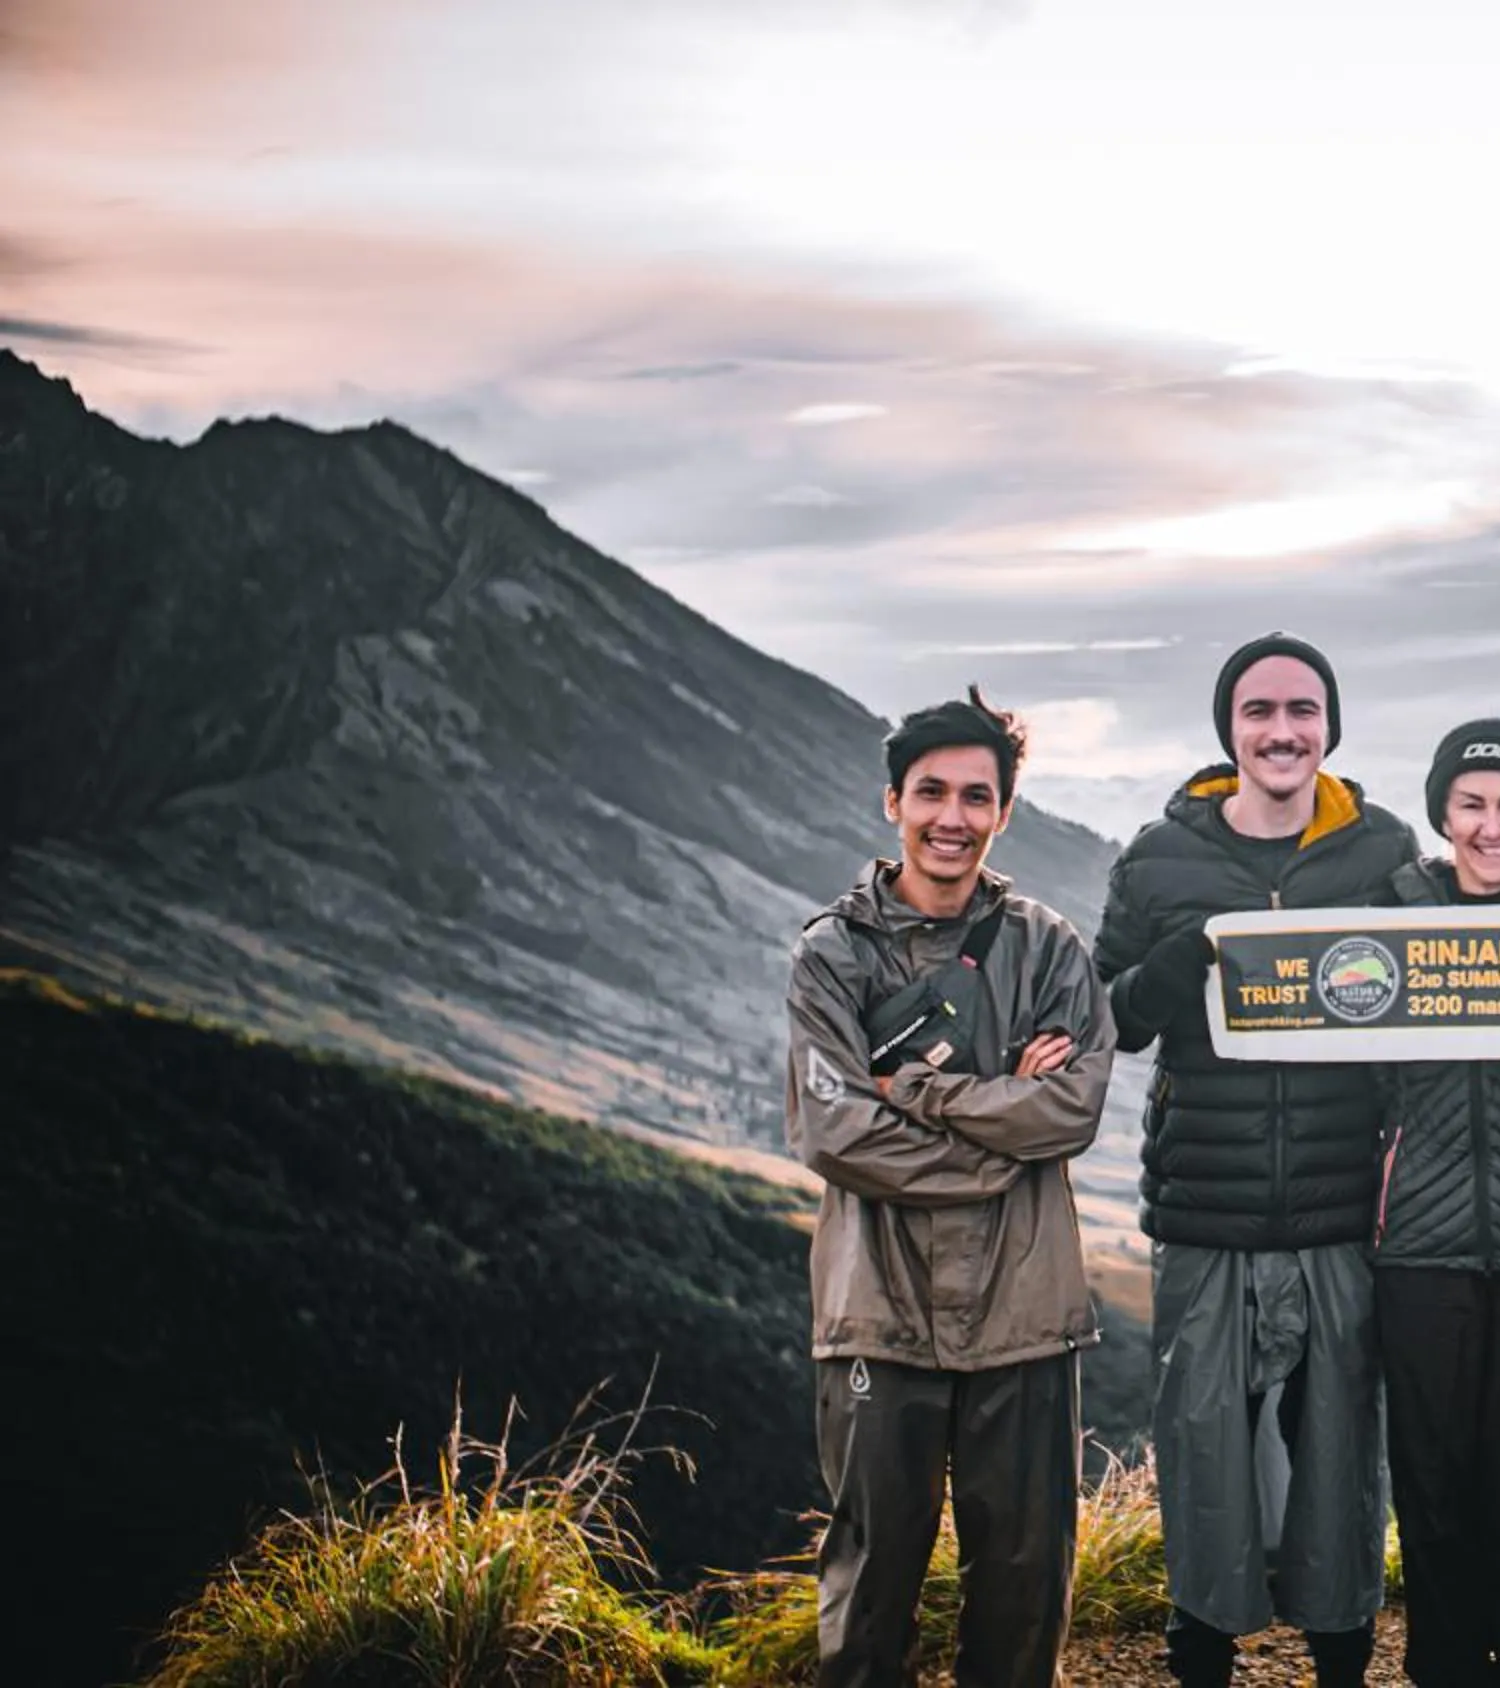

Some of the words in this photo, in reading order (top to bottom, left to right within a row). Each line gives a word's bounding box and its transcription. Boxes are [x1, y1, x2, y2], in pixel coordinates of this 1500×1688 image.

[1275, 958, 1309, 979] WE
[1407, 967, 1443, 989] 2ND
[1238, 983, 1308, 1006] TRUST
[1408, 993, 1463, 1016] 3200
